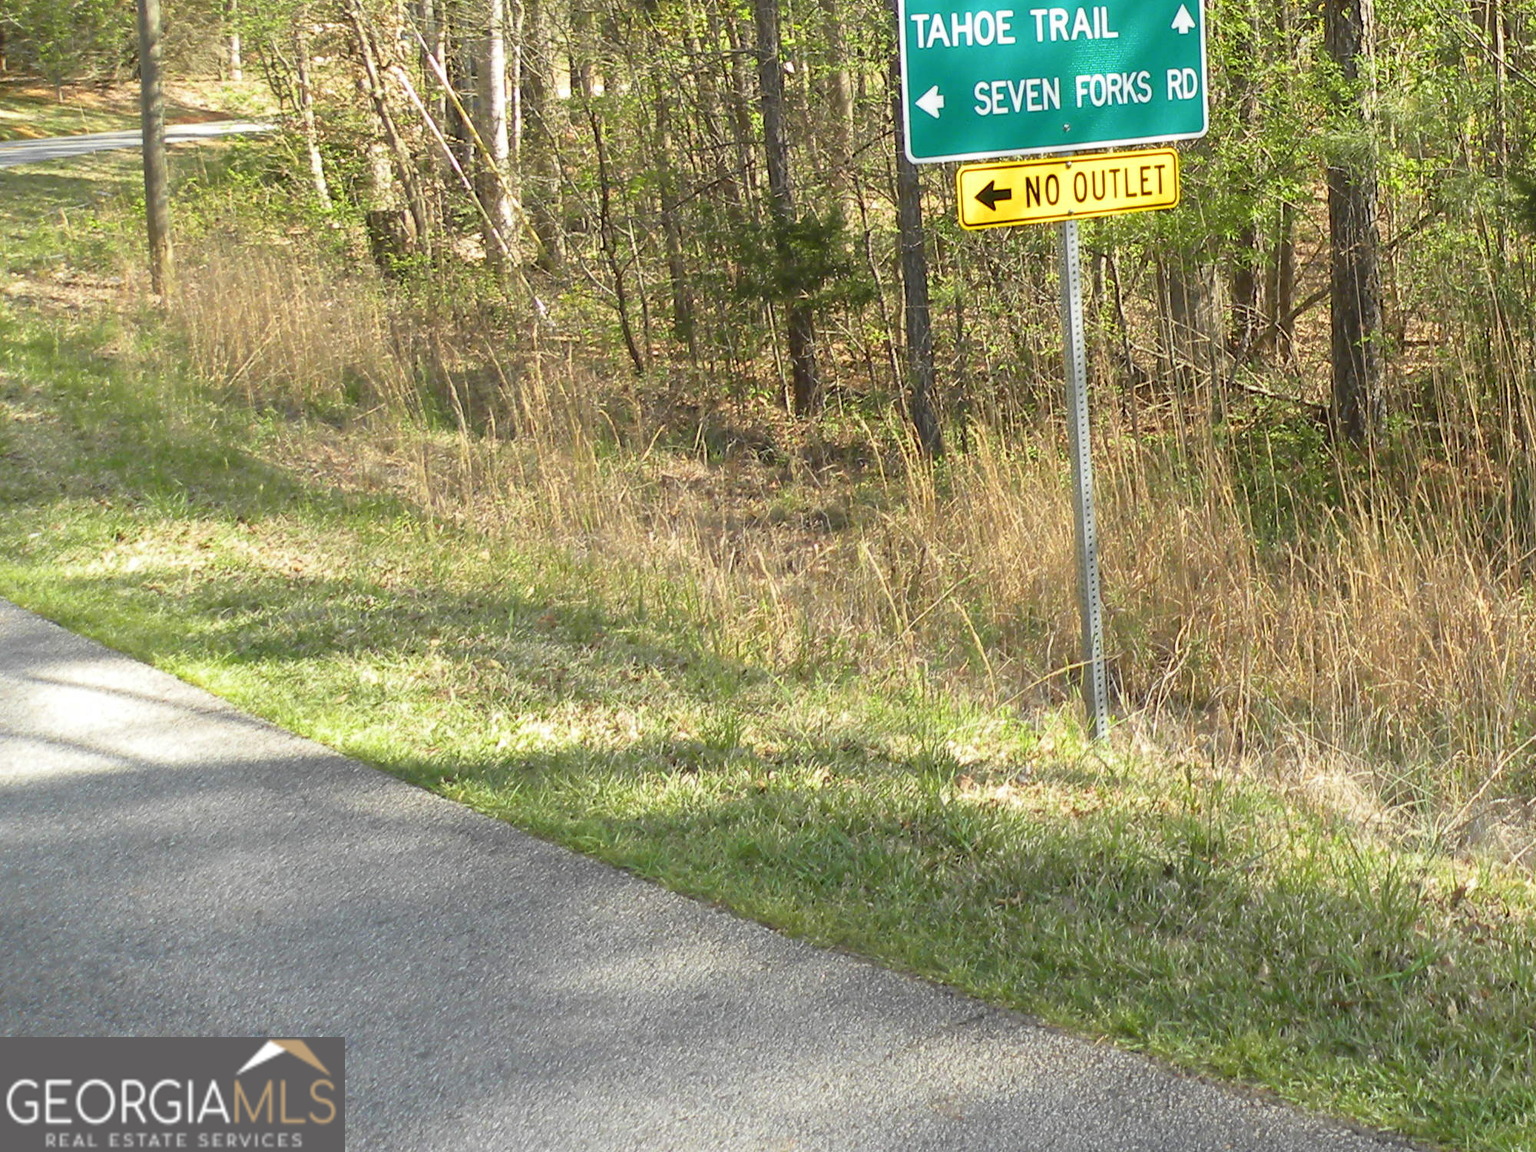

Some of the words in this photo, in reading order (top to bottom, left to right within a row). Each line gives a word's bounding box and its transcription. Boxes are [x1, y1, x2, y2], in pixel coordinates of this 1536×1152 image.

[911, 10, 1016, 48] TAHOE
[1030, 6, 1119, 42] TRAIL
[973, 77, 1061, 116] SEVEN
[1075, 71, 1153, 108] FORKS
[1167, 68, 1199, 101] RD
[1025, 174, 1060, 208] NO
[1073, 164, 1166, 203] OUTLET
